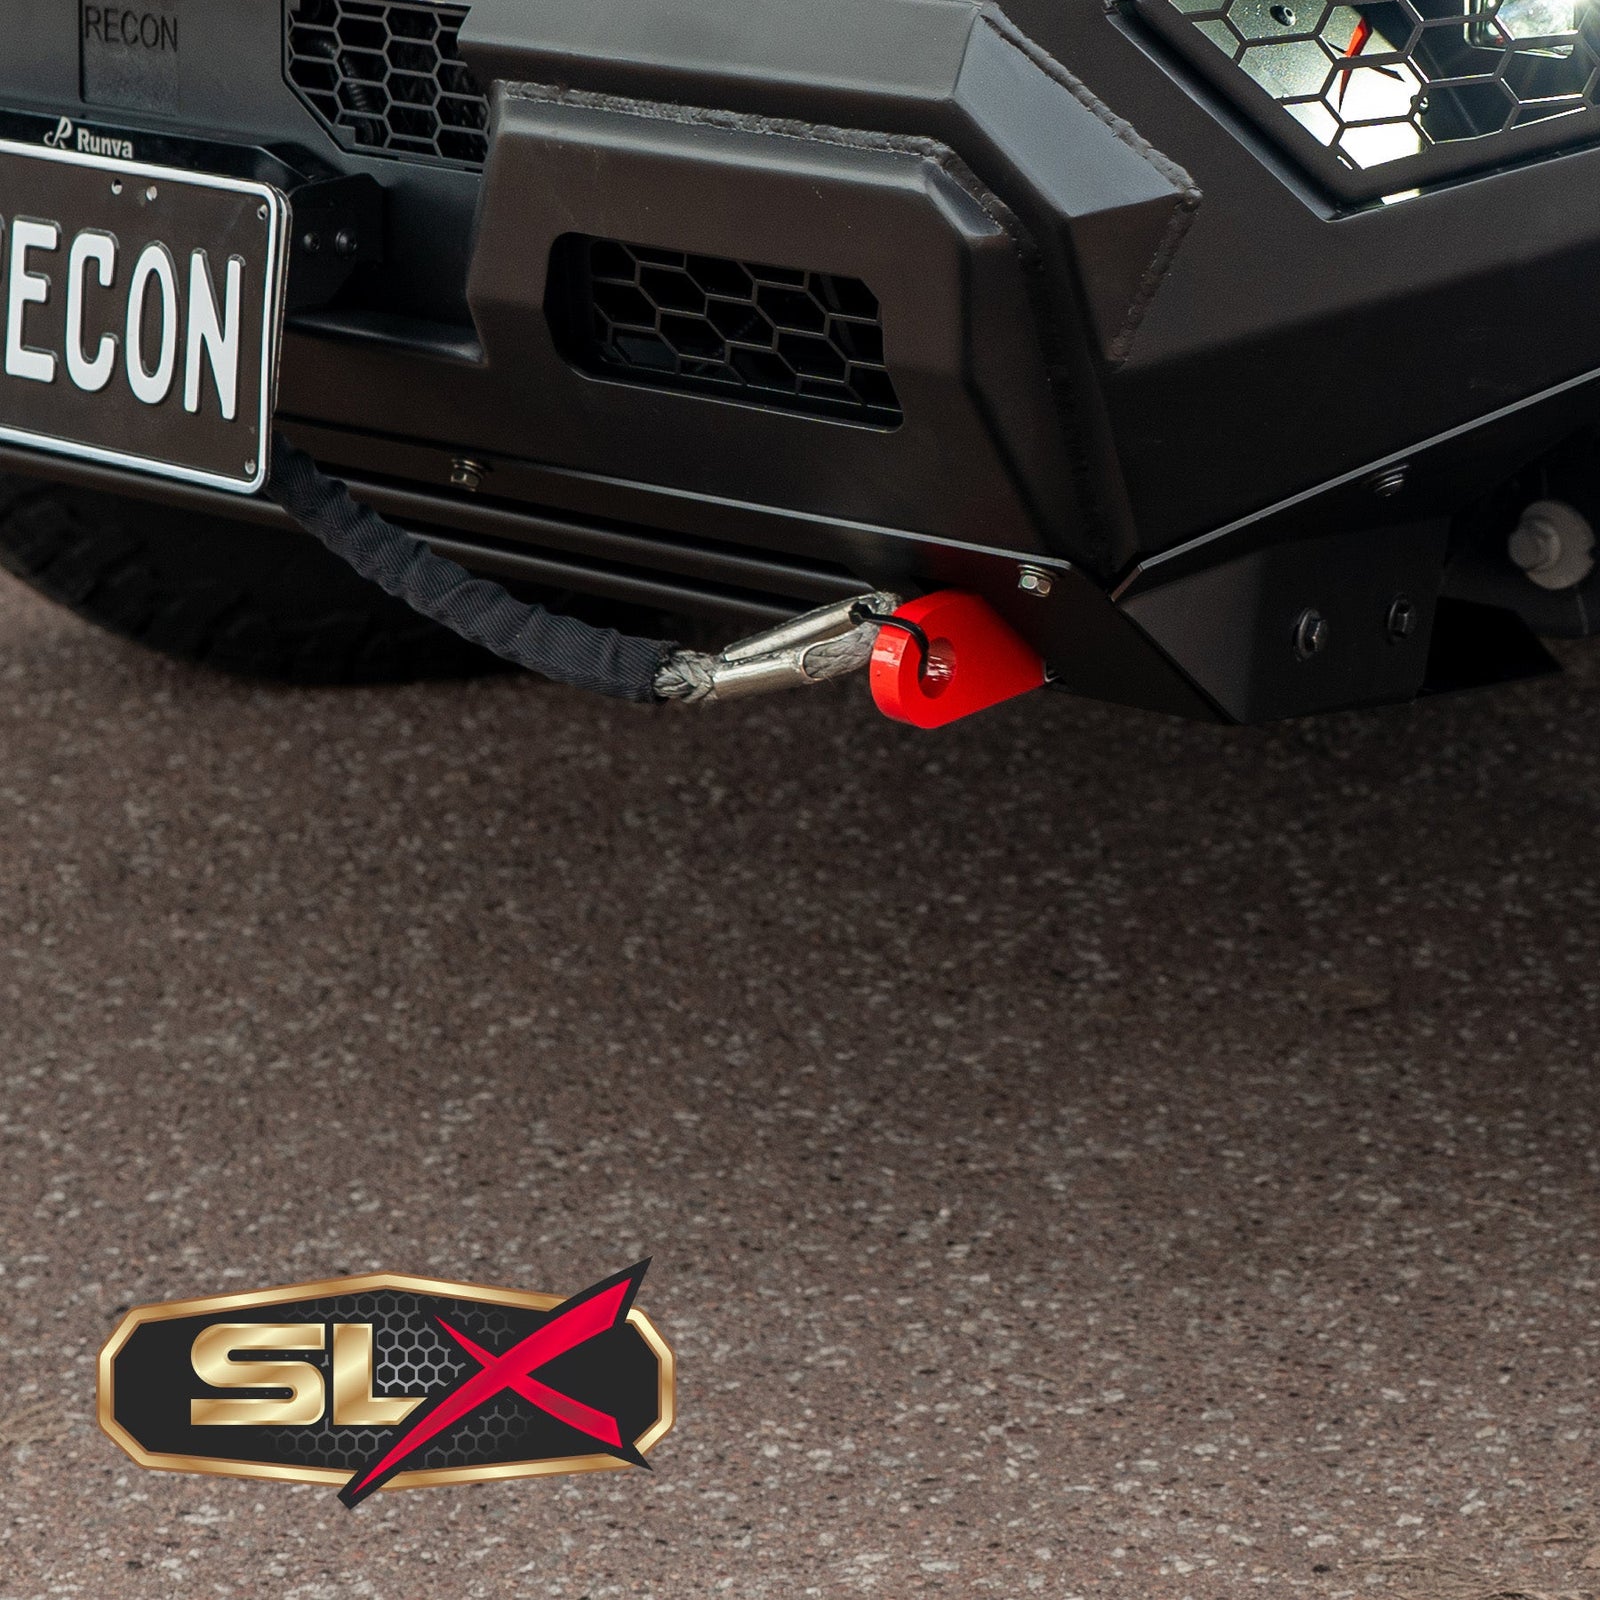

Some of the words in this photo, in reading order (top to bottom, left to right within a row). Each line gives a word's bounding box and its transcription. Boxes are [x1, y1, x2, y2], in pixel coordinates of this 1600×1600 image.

[84, 5, 178, 52] RECON
[77, 128, 134, 159] Runva
[0, 217, 243, 420] ECON
